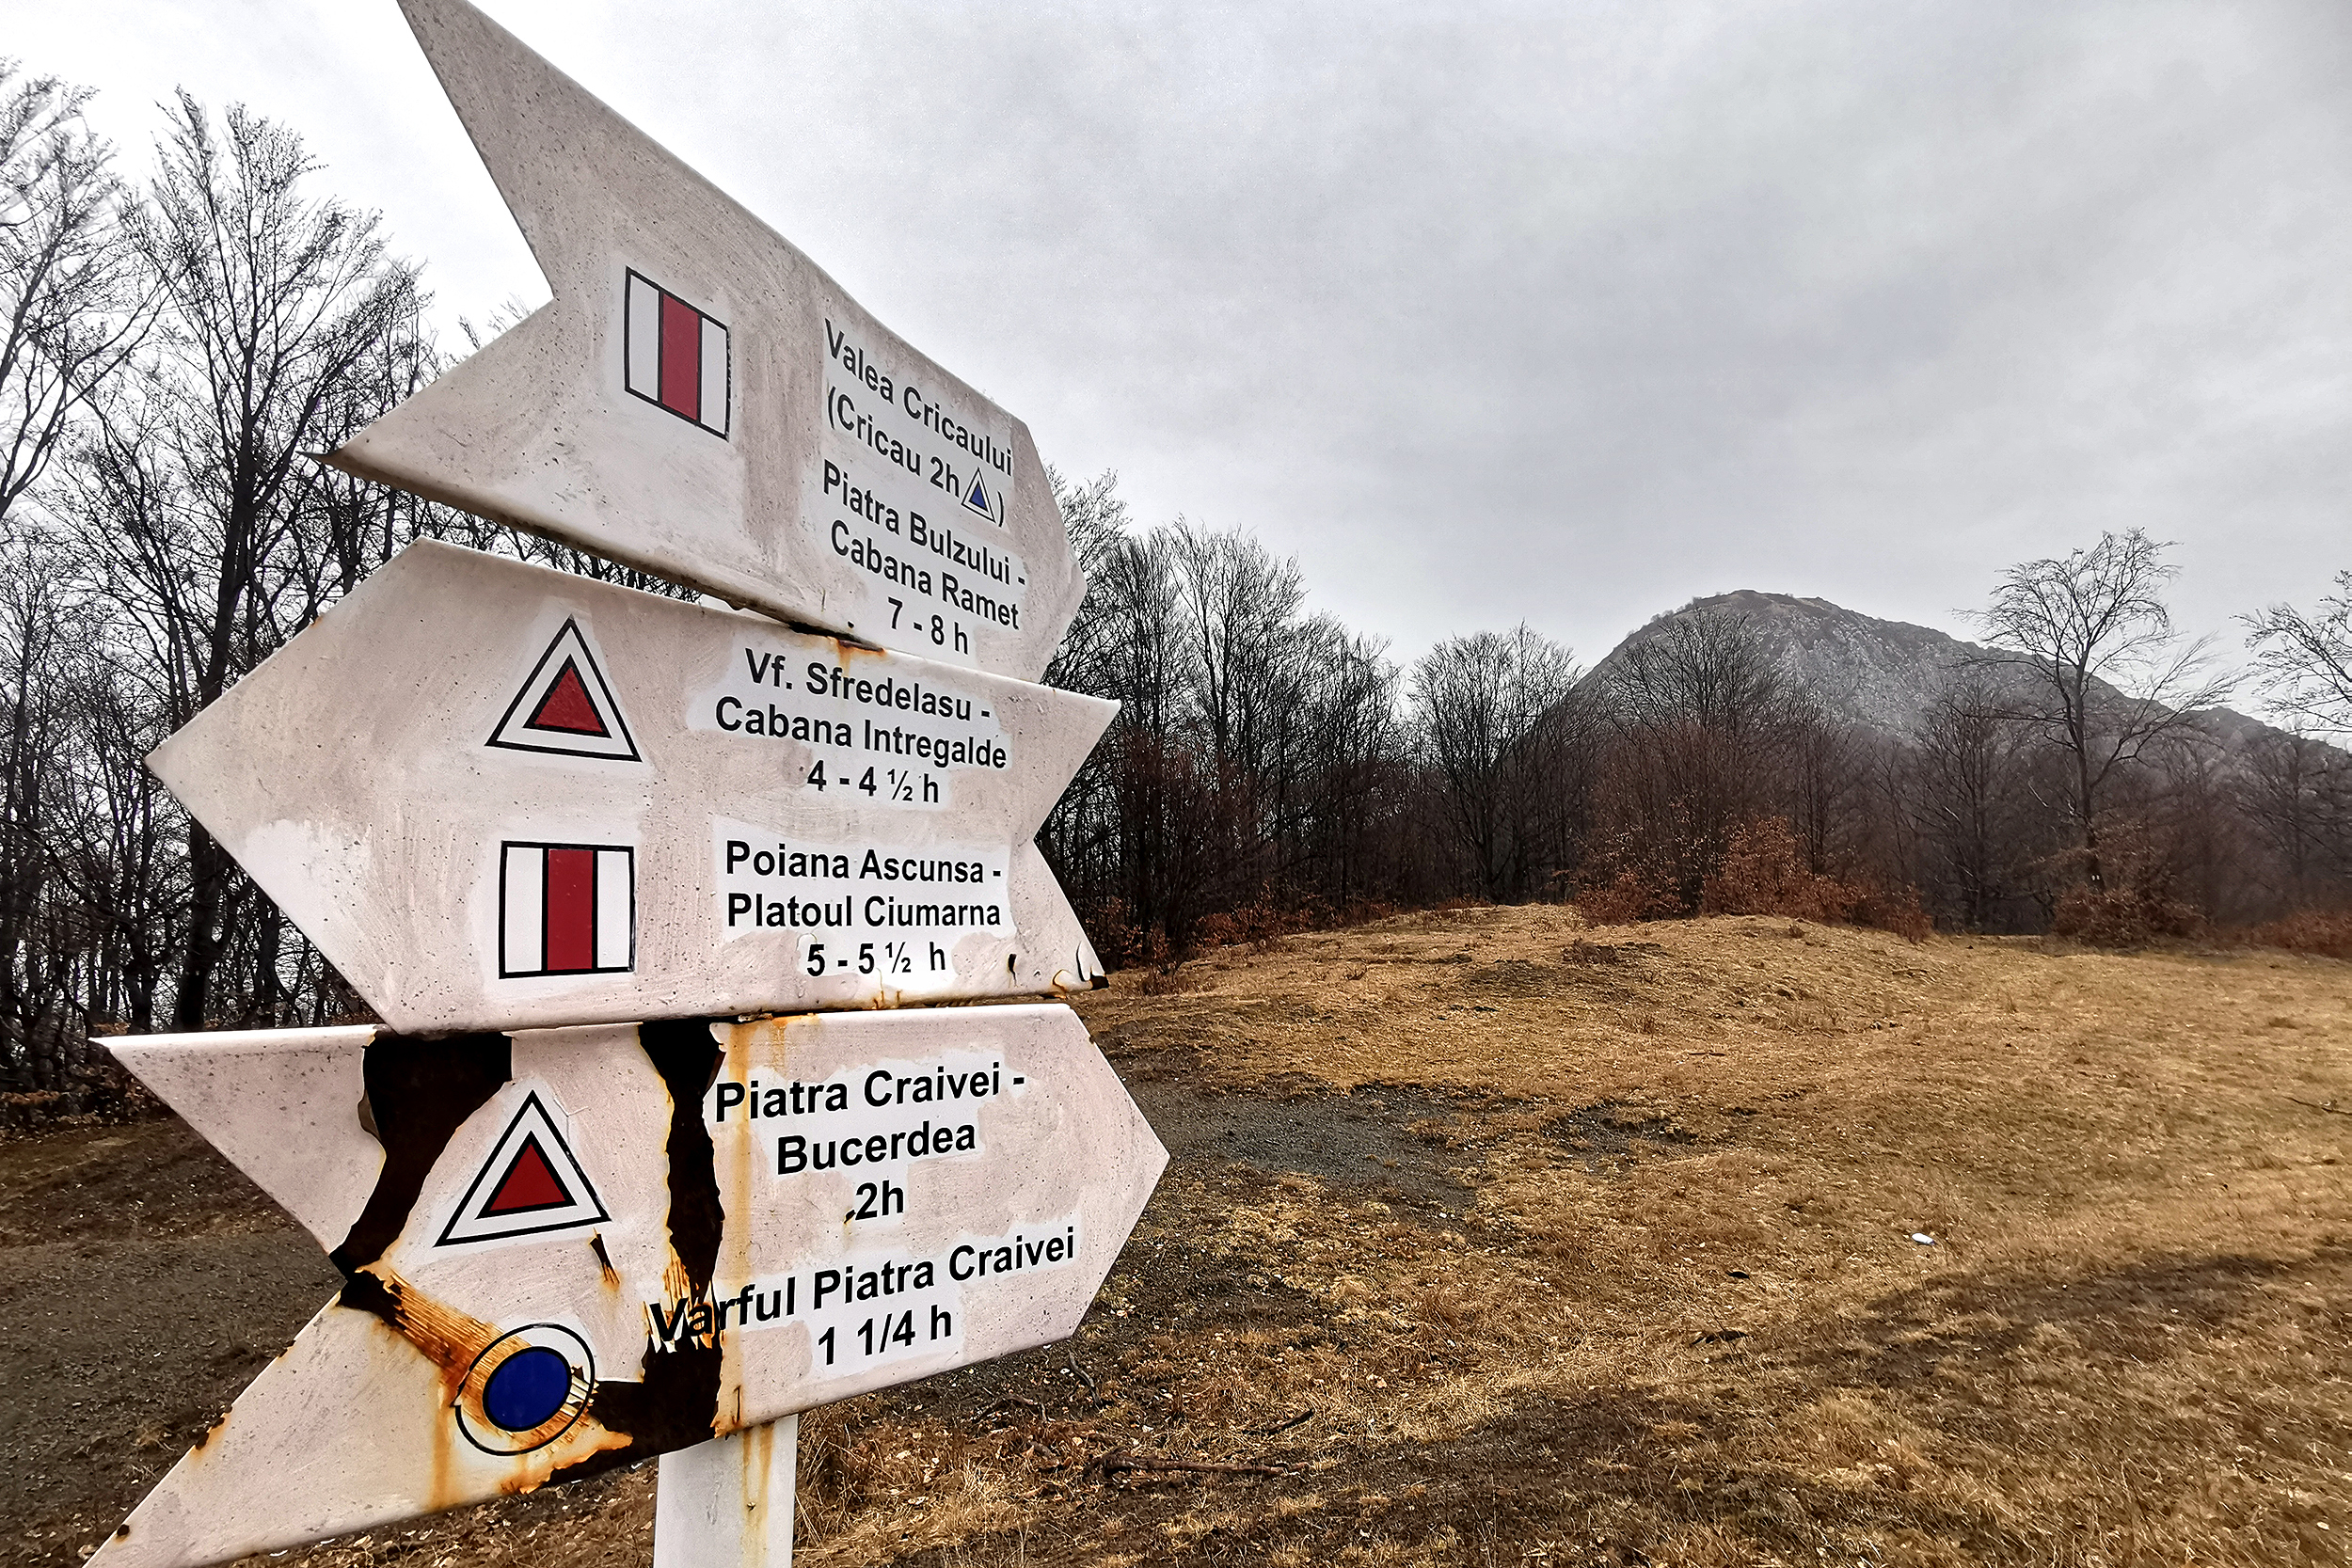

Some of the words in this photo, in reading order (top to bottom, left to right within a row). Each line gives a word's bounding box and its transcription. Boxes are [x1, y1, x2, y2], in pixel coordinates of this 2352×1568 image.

[825, 318, 894, 404] Valea
[904, 387, 1012, 476] Cricaului
[828, 387, 921, 476] (Cricau
[930, 457, 960, 498] 2h
[824, 459, 899, 535] Piatra
[910, 512, 1010, 585] Bulzului
[1018, 576, 1025, 585] -
[832, 519, 931, 595] Cabana
[942, 574, 1019, 629] Ramet
[887, 597, 903, 629] 7
[914, 622, 922, 630] -
[931, 615, 944, 645] 8
[955, 622, 968, 655] h
[745, 648, 793, 689] Vf.
[806, 662, 971, 721] Sfredelasu
[716, 697, 851, 748] Cabana
[865, 719, 1007, 768] Intregalde
[807, 760, 826, 791] 4
[859, 767, 877, 797] 4
[923, 774, 939, 802] h
[726, 841, 848, 878] Poiana
[859, 849, 983, 883] Ascunsa
[728, 894, 851, 927] Platoul
[865, 896, 1000, 926] Ciumarna
[807, 943, 824, 976] 5
[858, 943, 874, 974] 5
[930, 942, 945, 971] h
[716, 1078, 847, 1122] Piatra
[864, 1062, 1000, 1107] Craivei
[1013, 1077, 1025, 1085] -
[778, 1121, 976, 1175] Bucerdea
[855, 1180, 904, 1221] 2h
[650, 1277, 795, 1343] Varful
[814, 1259, 934, 1309] Piatra
[948, 1227, 1074, 1281] Craivei
[818, 1327, 834, 1365] 1
[857, 1310, 914, 1357] 1/4
[930, 1305, 951, 1339] h
